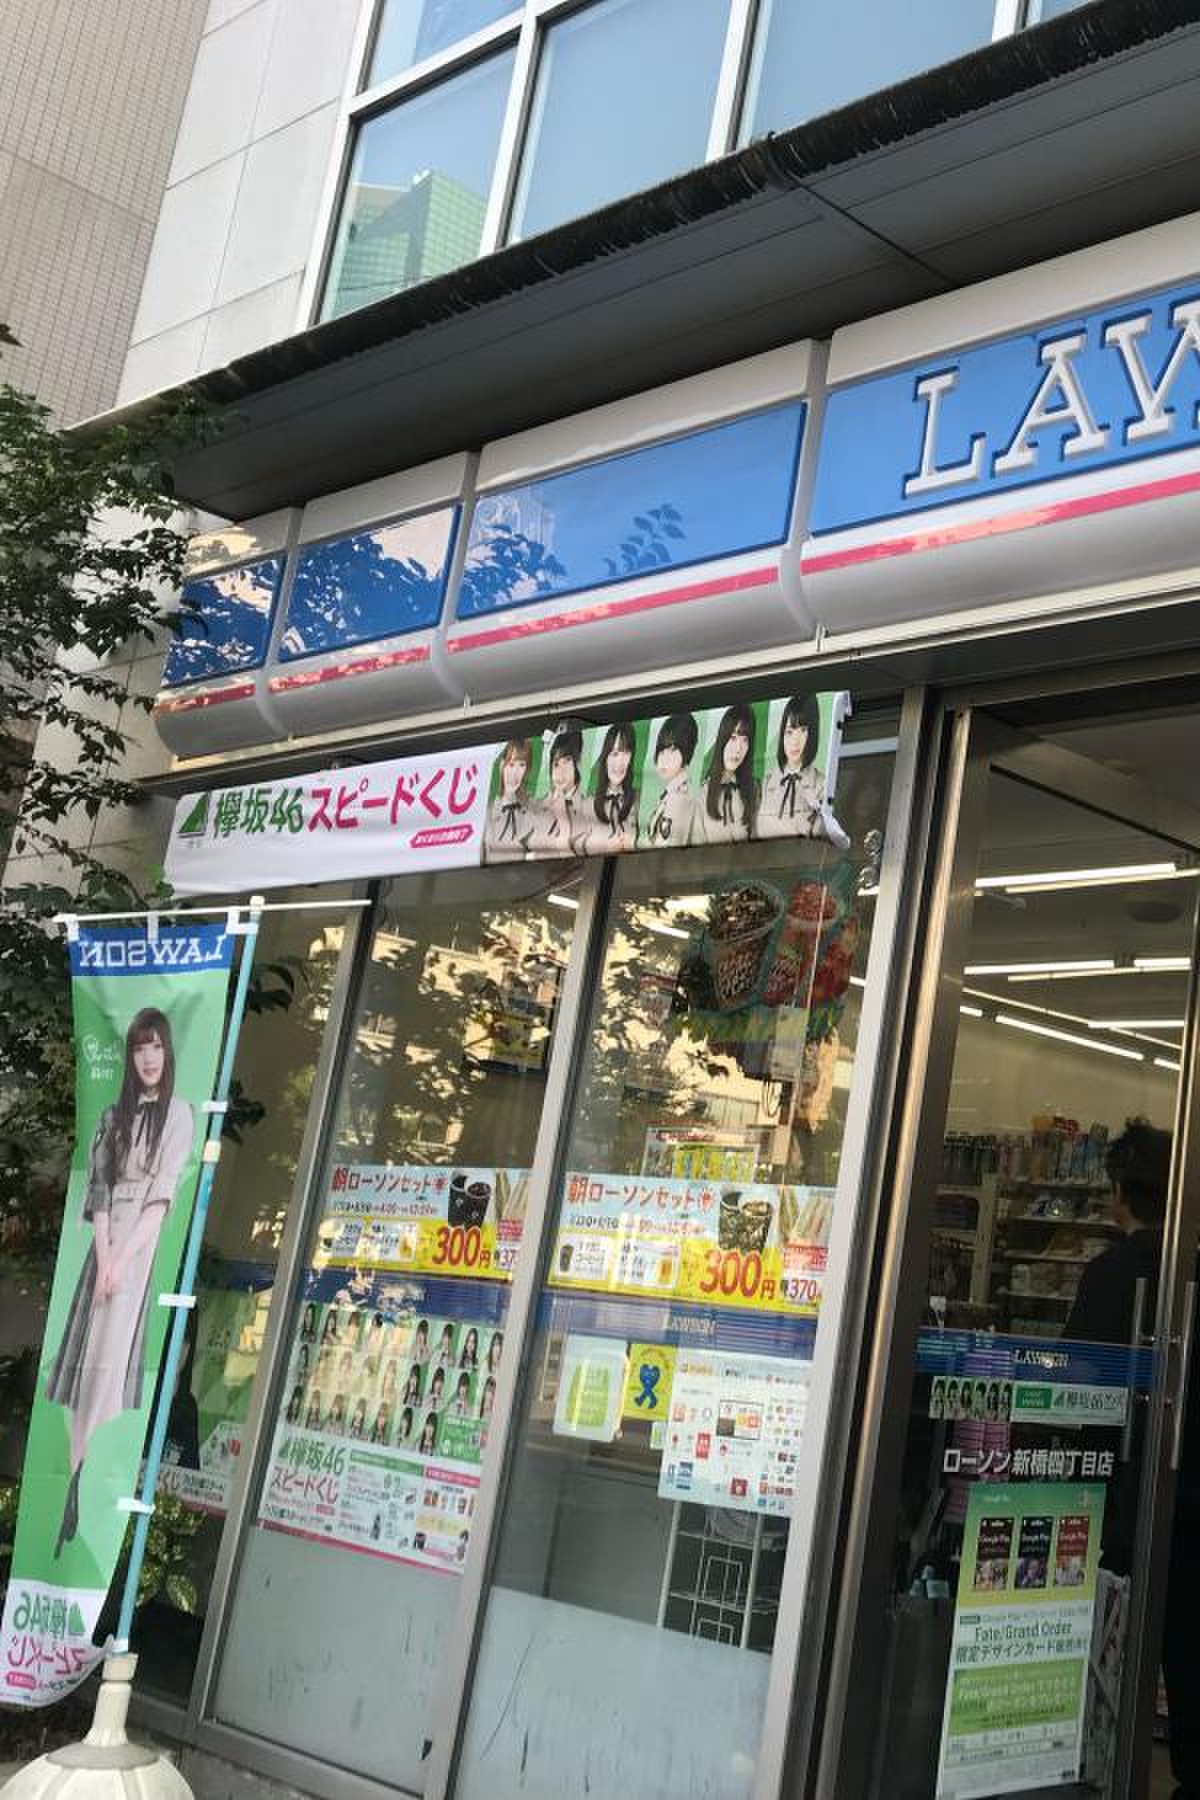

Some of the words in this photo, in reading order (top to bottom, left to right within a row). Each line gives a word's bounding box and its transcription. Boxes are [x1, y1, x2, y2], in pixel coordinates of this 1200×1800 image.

[699, 1249, 776, 1300] 300円
[943, 1449, 1114, 1476] ローソン新橋四丁目店
